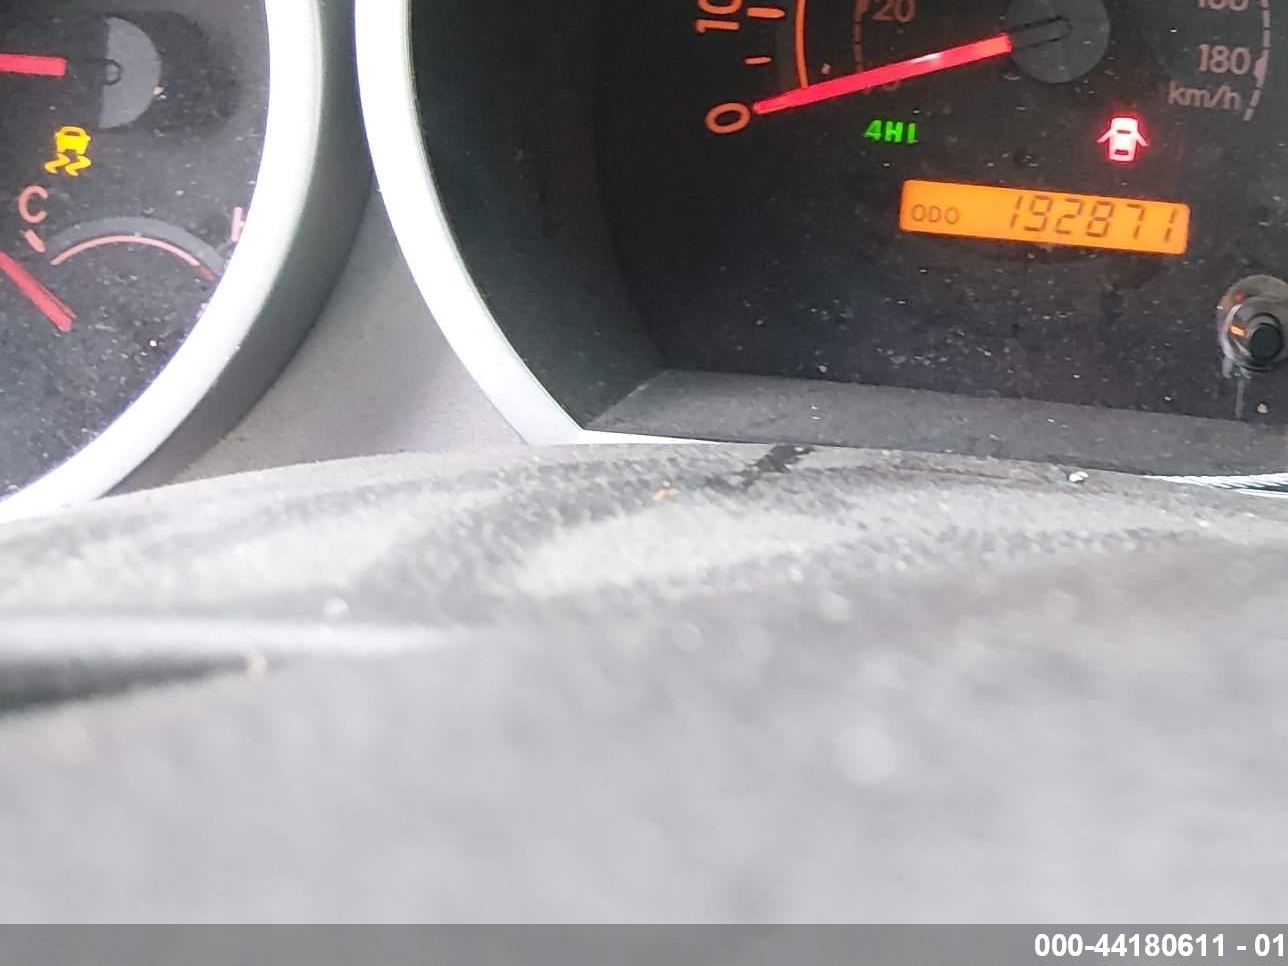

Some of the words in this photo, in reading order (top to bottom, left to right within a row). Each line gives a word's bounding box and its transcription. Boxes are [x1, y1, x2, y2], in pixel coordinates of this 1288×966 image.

[1199, 44, 1250, 74] 180
[1168, 82, 1241, 109] km/h
[706, 103, 750, 133] 0
[18, 186, 48, 223] C
[911, 204, 961, 225] ODO
[1008, 194, 1178, 242] 192871
